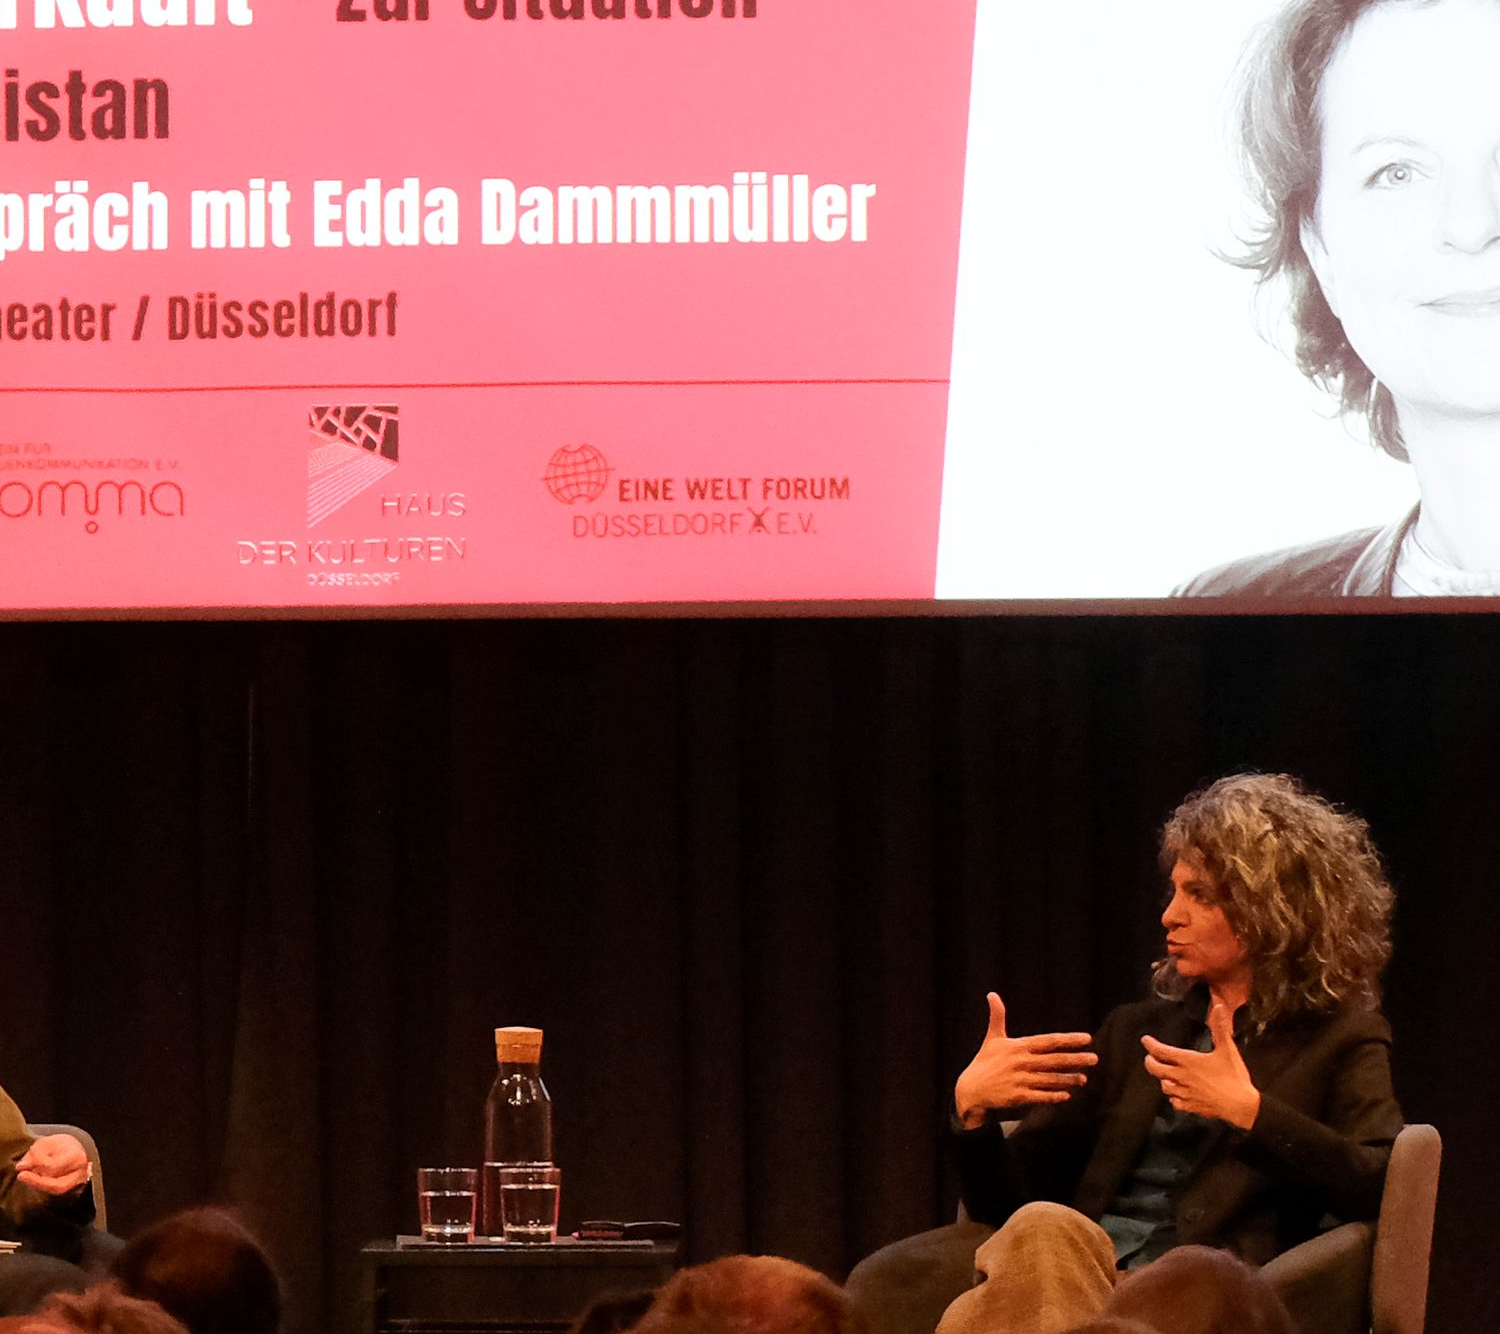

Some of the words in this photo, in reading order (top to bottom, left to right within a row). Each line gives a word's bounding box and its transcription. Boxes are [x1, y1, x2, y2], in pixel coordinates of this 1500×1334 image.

[190, 178, 292, 250] mit
[313, 178, 459, 248] Edda
[481, 172, 877, 247] Dammmüller
[131, 294, 151, 341] /
[167, 291, 399, 341] Düsseldorf
[618, 478, 674, 502] EINE
[685, 477, 752, 502] WELT
[762, 477, 850, 501] FORUM
[380, 492, 467, 517] HAUS
[572, 511, 744, 538] DÜSSELDORF
[777, 512, 817, 535] E.V.
[237, 540, 297, 565] DER
[307, 537, 467, 565] KULTUREN
